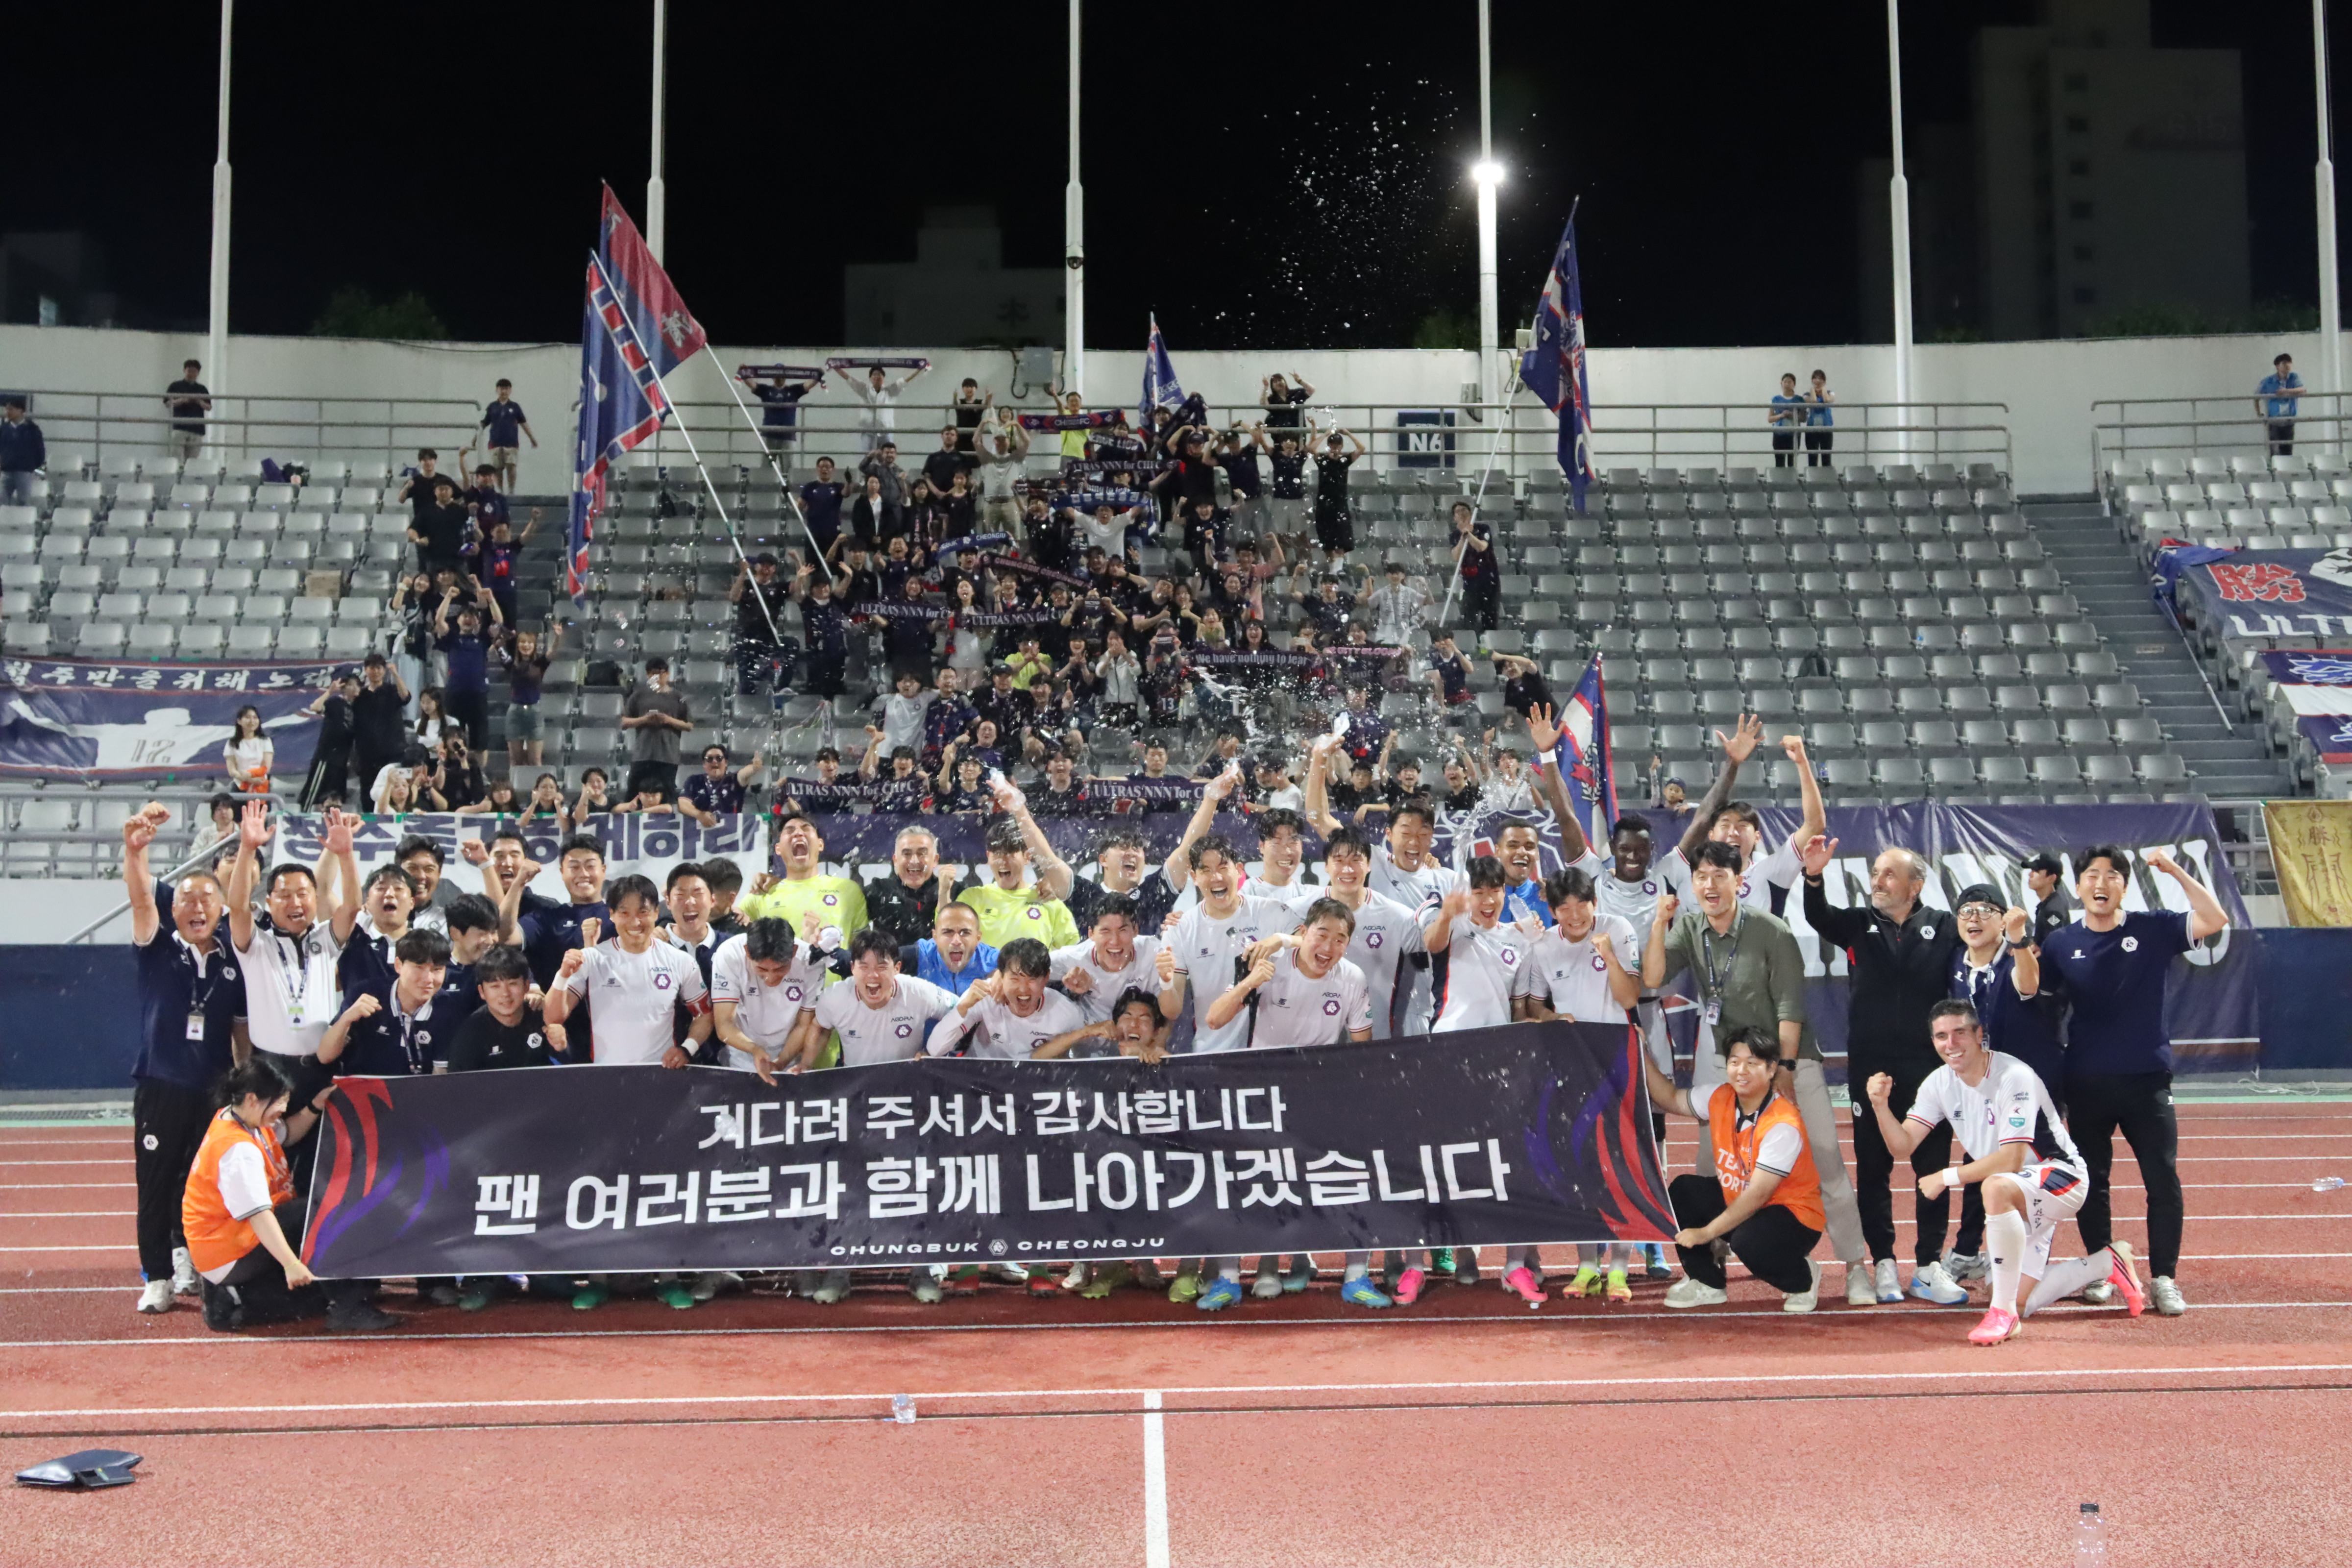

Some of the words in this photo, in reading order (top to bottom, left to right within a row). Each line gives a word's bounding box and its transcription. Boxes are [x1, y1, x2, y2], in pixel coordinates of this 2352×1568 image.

[1409, 433, 1441, 452] N6
[976, 532, 1006, 541] CHEONGJU
[860, 603, 899, 616] ULTRAS
[972, 613, 1010, 626] ULTRAS
[1196, 653, 1211, 664] We
[1212, 652, 1236, 663] have
[1238, 653, 1274, 665] nothing
[131, 739, 175, 763] 12
[786, 783, 829, 796] ULTRAS
[832, 785, 860, 796] NNN
[863, 785, 879, 796] for
[1094, 784, 1143, 798] ULTRAS
[1144, 786, 1175, 799] NNN
[1175, 786, 1192, 799] for
[698, 1098, 847, 1149] 기다려
[866, 1094, 1016, 1139] 주셔서
[1032, 1086, 1287, 1135] 감사합니다
[474, 1174, 539, 1235] 팬
[565, 1161, 846, 1230] 여러분과
[866, 1154, 1001, 1219] 함께
[1026, 1138, 1511, 1212] 나아가겠습니다
[830, 1242, 980, 1256] CHUNGBUK
[1017, 1237, 1165, 1251] CHEONGJU
